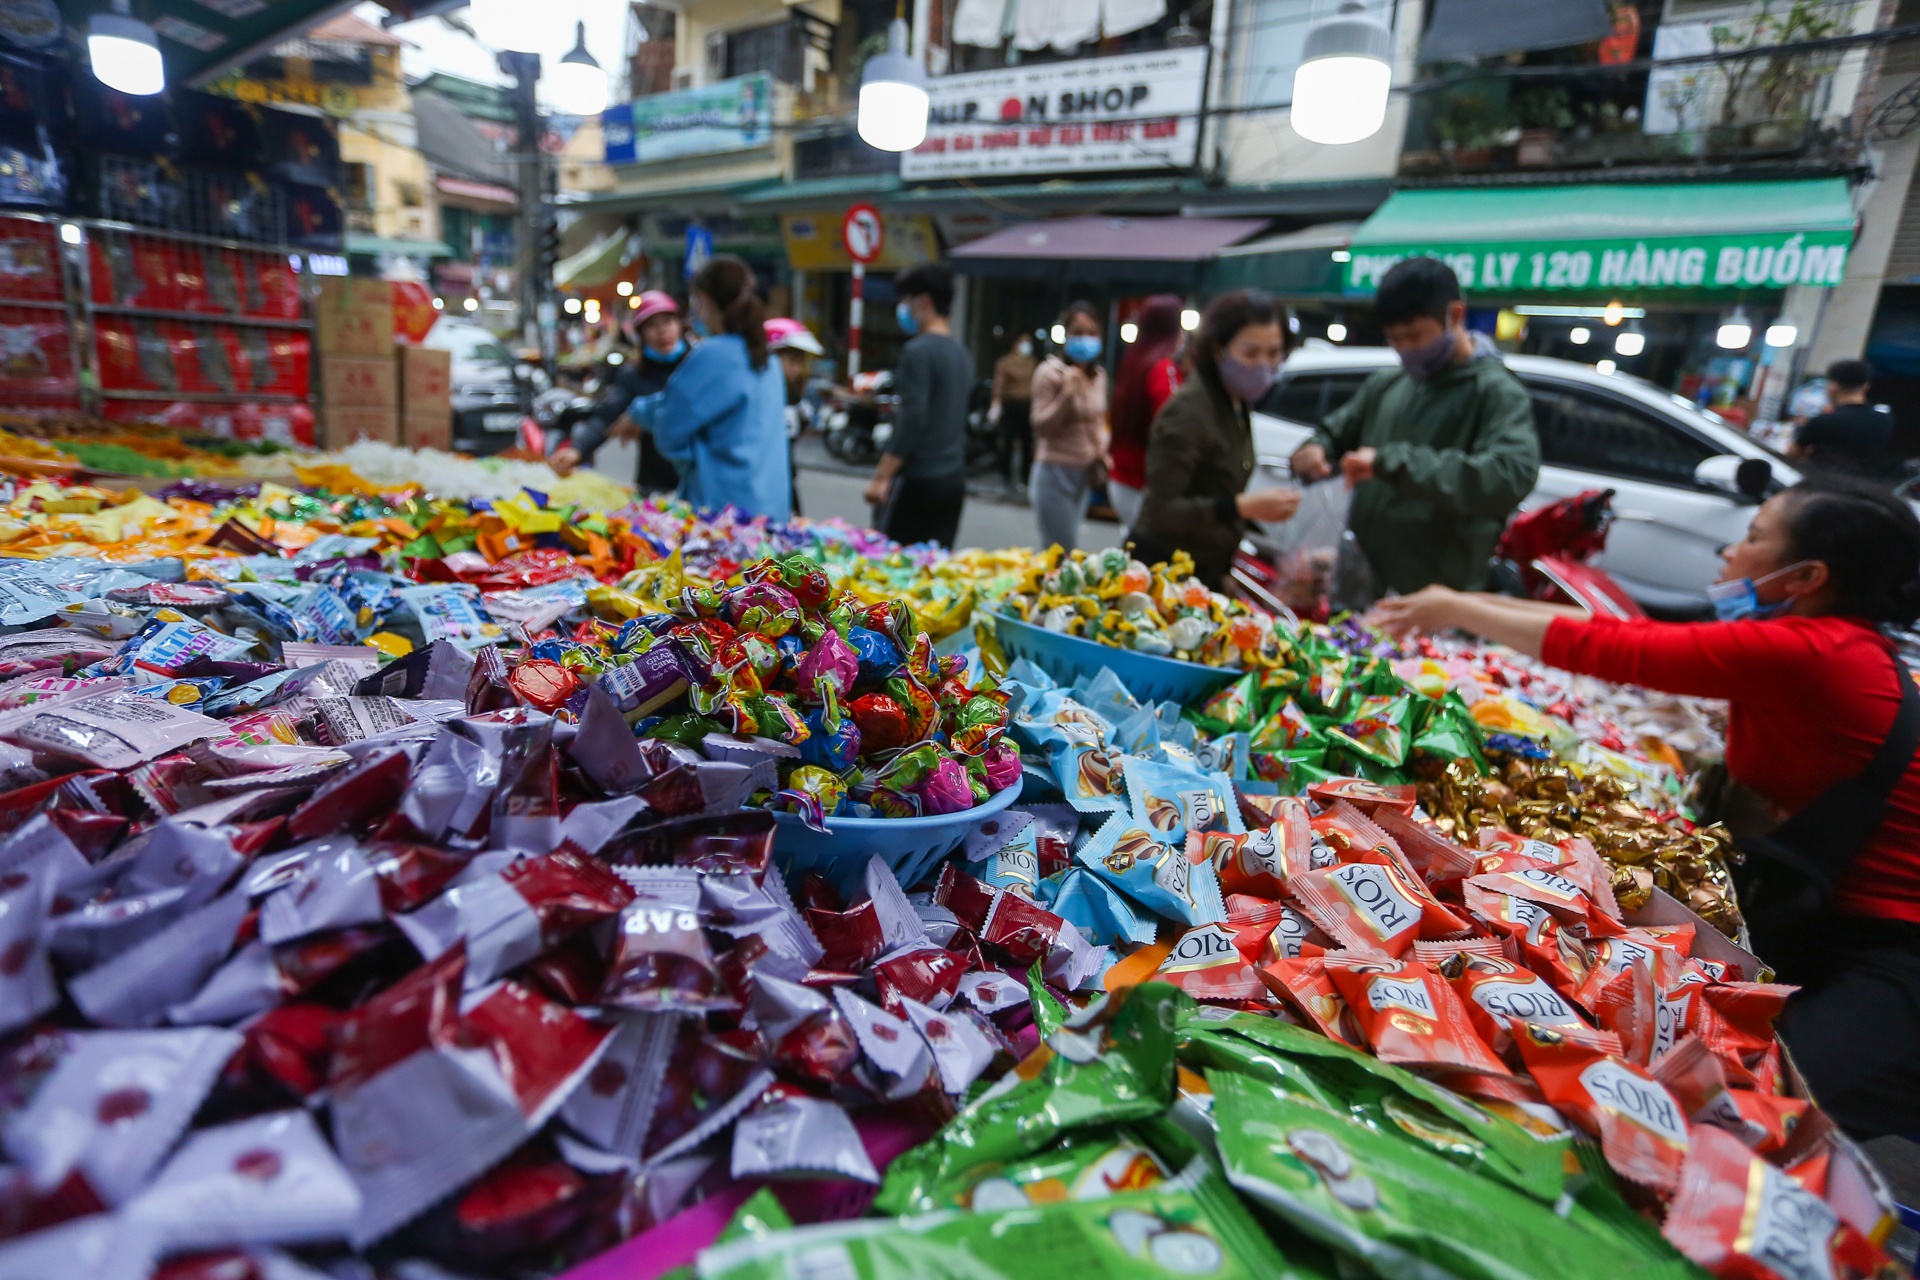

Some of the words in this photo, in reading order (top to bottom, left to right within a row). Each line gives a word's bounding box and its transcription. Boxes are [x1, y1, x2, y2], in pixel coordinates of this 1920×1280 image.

[1059, 85, 1148, 115] SHOP
[1481, 253, 1519, 287] LY
[1530, 252, 1592, 287] 120
[1599, 242, 1706, 287] HÀNG
[1000, 852, 1036, 874] RIO'S
[1339, 865, 1409, 931] RIO'S
[1373, 985, 1429, 1010] RIO'S
[1488, 991, 1569, 1018] RIO'S
[1592, 1073, 1678, 1132] RIO'S
